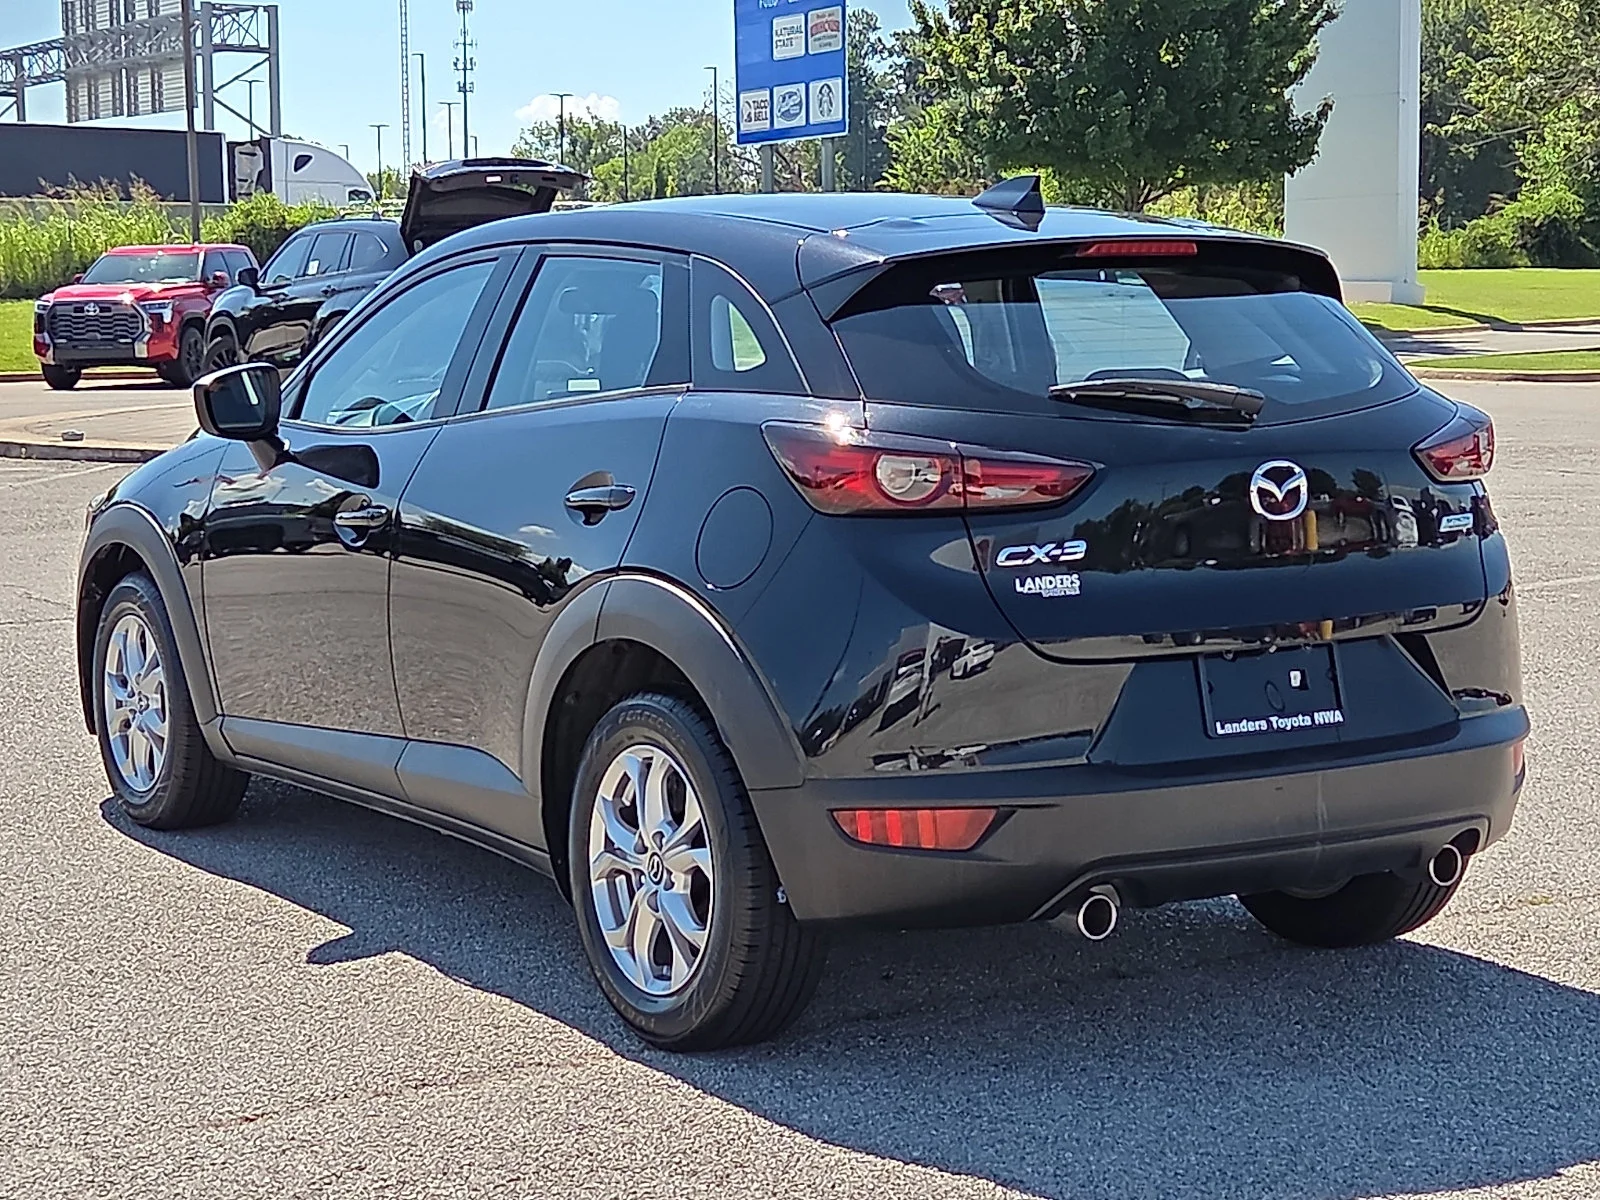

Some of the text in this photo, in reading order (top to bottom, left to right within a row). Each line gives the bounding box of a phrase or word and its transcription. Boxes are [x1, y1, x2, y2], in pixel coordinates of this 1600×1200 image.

[752, 98, 769, 111] TACO
[753, 110, 769, 122] BELL
[996, 540, 1087, 566] CX-3
[1015, 573, 1080, 593] LANDERS
[1216, 709, 1344, 735] Landers Toyota NWA
